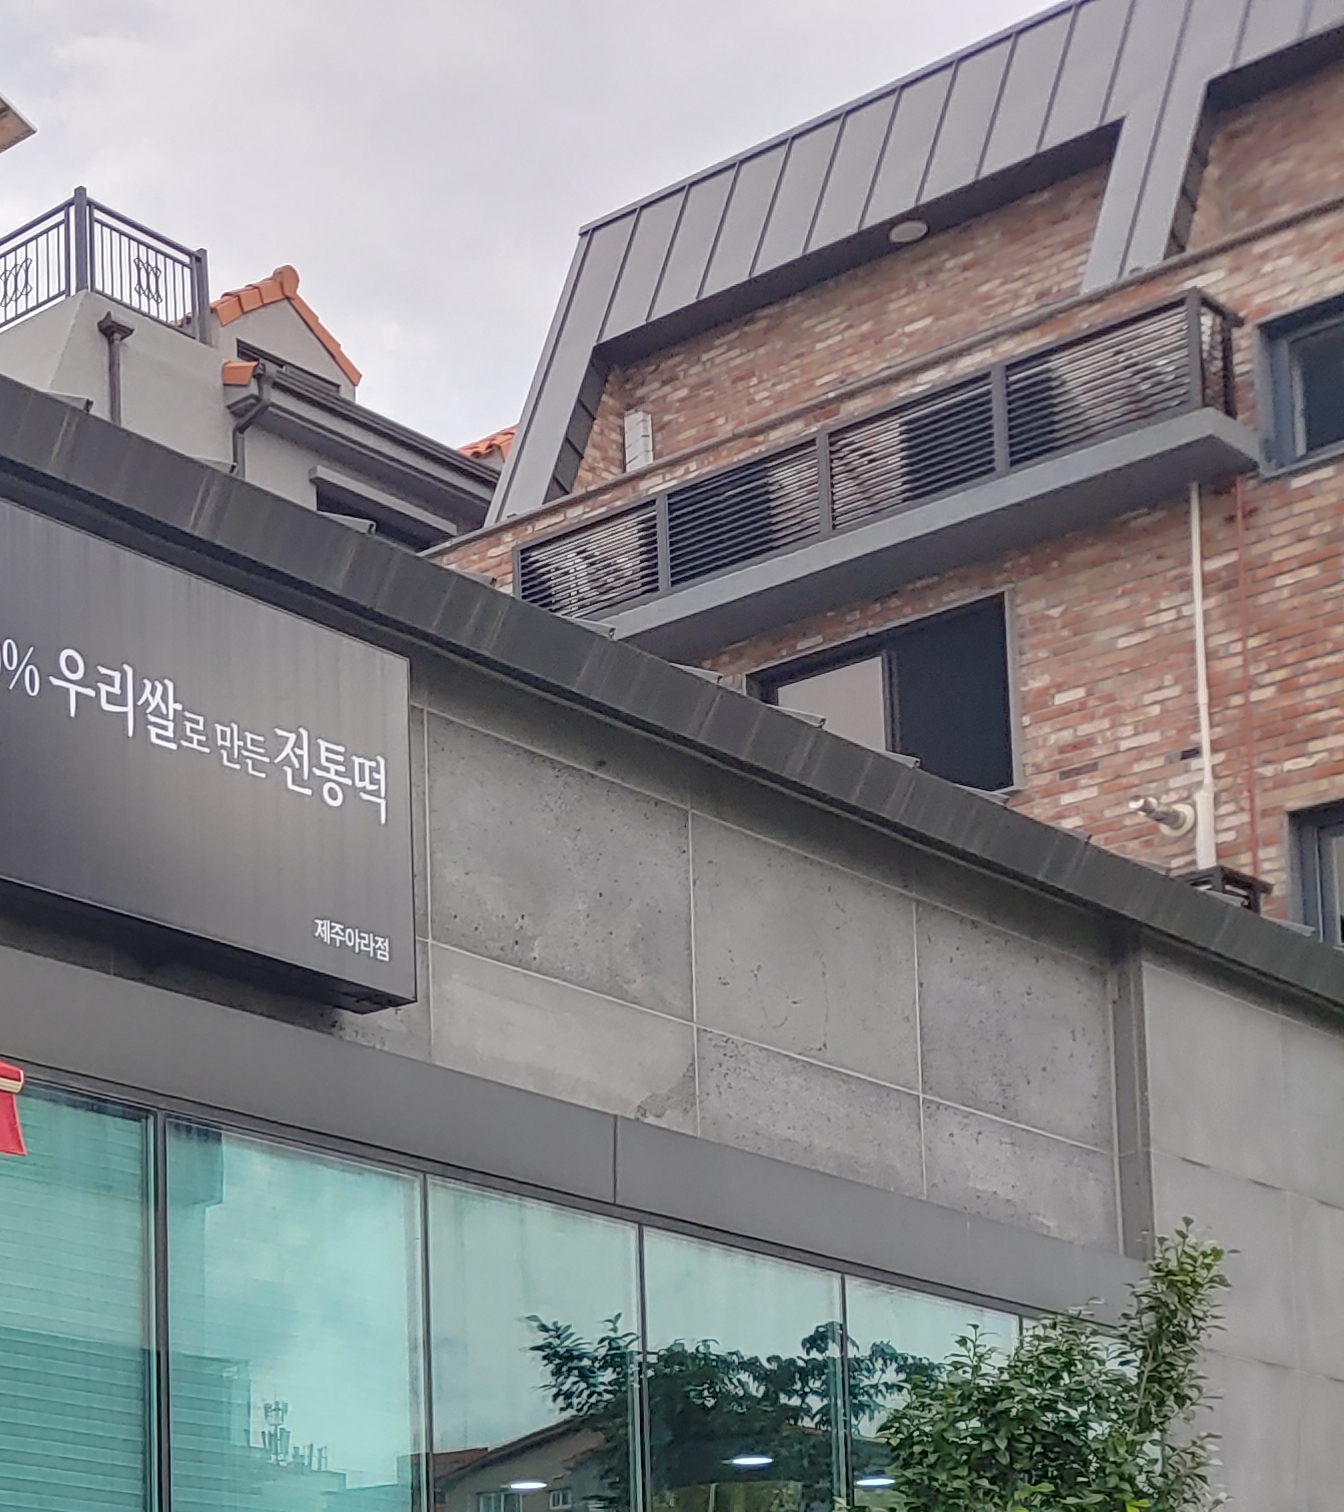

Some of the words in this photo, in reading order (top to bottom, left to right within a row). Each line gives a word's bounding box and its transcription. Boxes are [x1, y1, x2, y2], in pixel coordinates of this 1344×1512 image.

[49, 647, 210, 754] 우리쌀로
[215, 721, 270, 778] 만든
[273, 725, 387, 825] 전통떡
[314, 918, 390, 962] 제주아라점
